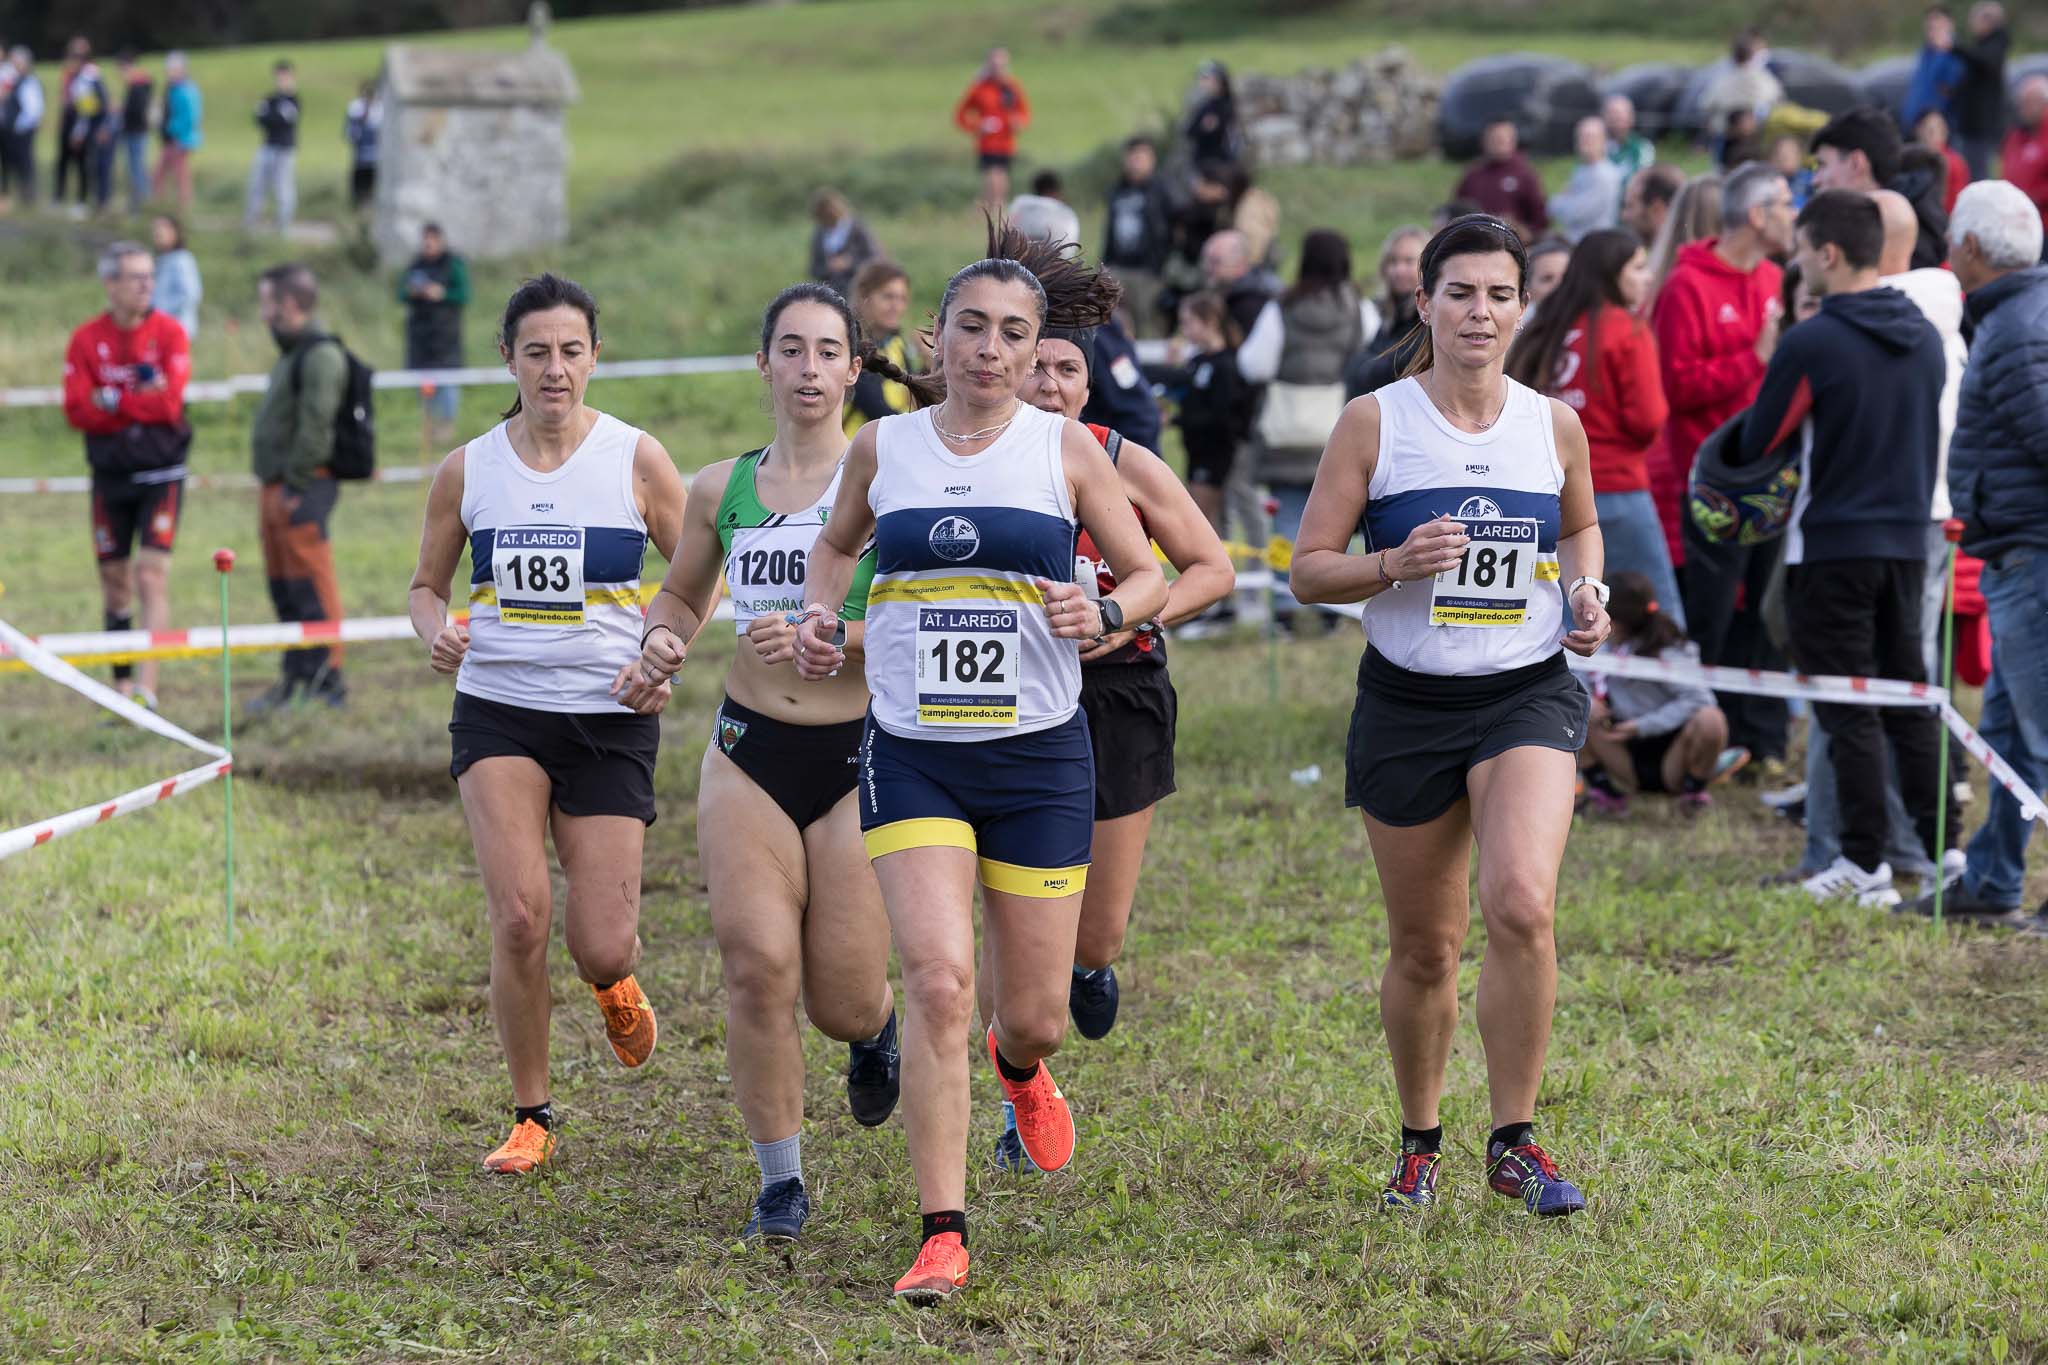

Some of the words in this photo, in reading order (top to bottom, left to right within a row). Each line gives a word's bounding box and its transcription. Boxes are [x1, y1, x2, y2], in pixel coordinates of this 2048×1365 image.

[1465, 464, 1490, 472] AMURA
[943, 485, 972, 493] AMURA
[1473, 524, 1532, 539] LAREDO
[501, 533, 519, 545] AT.
[523, 534, 577, 545] LAREDO
[507, 555, 570, 593] 183
[738, 549, 811, 586] 1206
[1457, 547, 1518, 589] 181
[753, 597, 799, 611] ESPAÑA
[503, 611, 581, 622] campinglaredo.com
[924, 613, 945, 627] AT.
[949, 614, 1012, 628] LAREDO
[1436, 610, 1522, 622] campinglaredo.com
[931, 639, 1005, 683] 182
[922, 708, 1013, 719] campinglaredo.com
